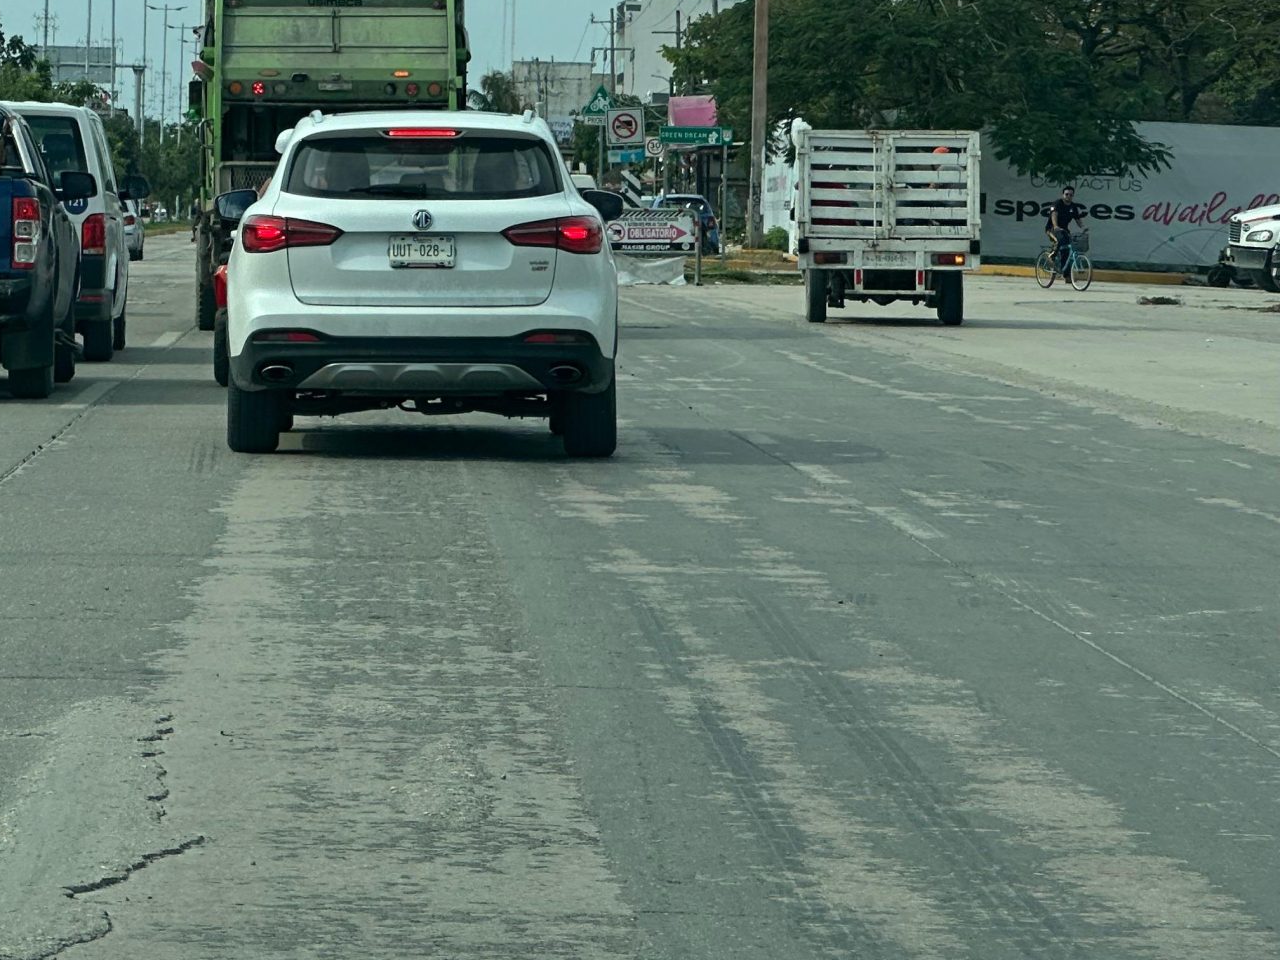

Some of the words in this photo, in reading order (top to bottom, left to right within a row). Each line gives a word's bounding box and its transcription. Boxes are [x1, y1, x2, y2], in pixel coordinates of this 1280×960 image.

[1118, 178, 1143, 192] US
[415, 212, 431, 227] MG
[629, 227, 677, 240] OBLIGATORIO
[392, 243, 454, 257] UUT-028-J
